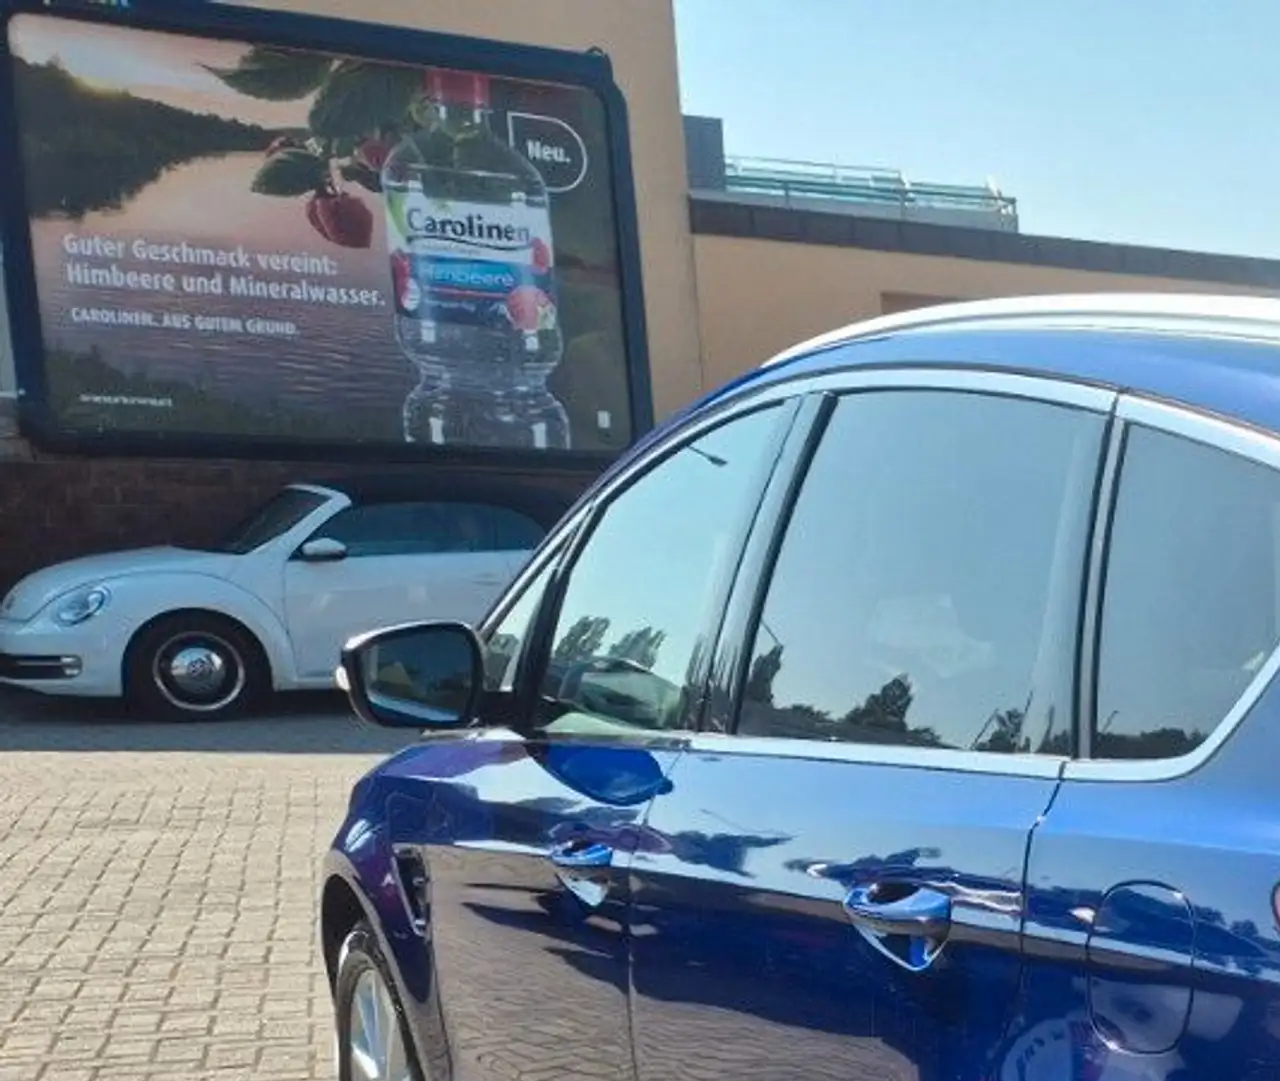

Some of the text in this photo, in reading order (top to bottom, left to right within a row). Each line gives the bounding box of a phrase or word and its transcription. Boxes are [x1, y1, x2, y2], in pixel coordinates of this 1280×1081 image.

[525, 139, 572, 163] Neu.
[406, 208, 530, 242] Carolinen
[63, 233, 338, 276] Guter Geschmack vereint:
[66, 263, 386, 306] Himbeere und Mineralwasser.
